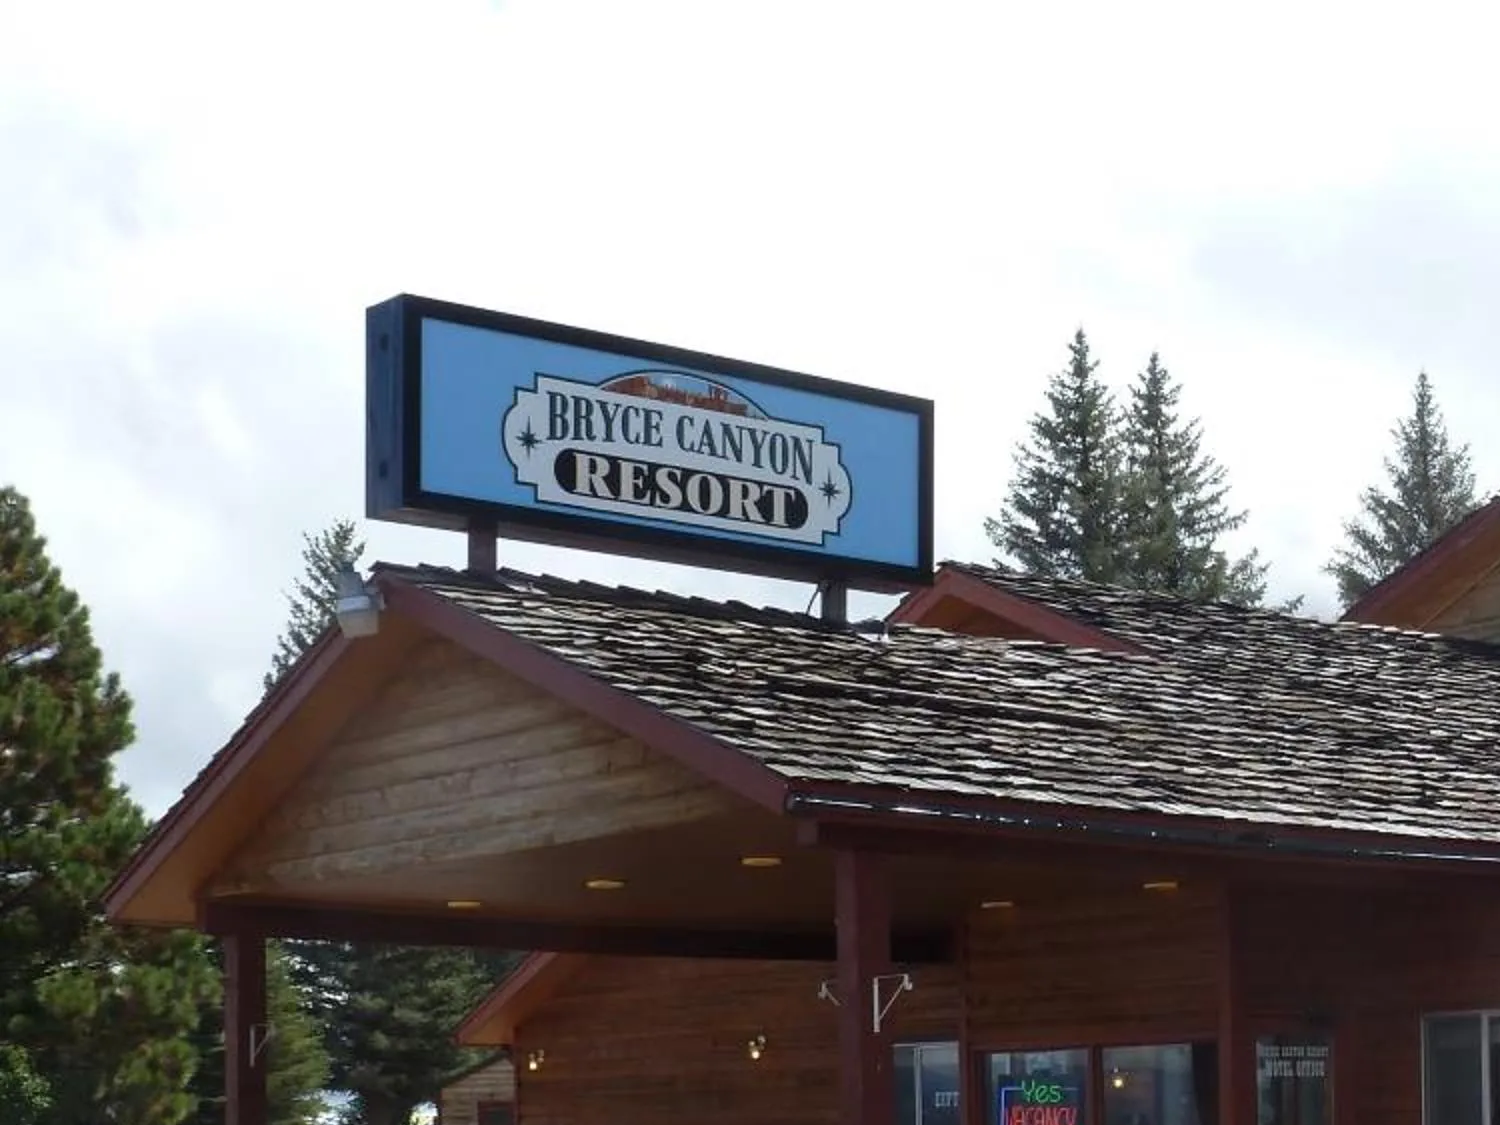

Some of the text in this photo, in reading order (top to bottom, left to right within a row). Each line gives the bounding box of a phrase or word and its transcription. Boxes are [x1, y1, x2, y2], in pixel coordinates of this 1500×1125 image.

[546, 390, 814, 486] BRYCE CANYON
[572, 451, 796, 528] RESORT
[1021, 1079, 1062, 1103] Yes
